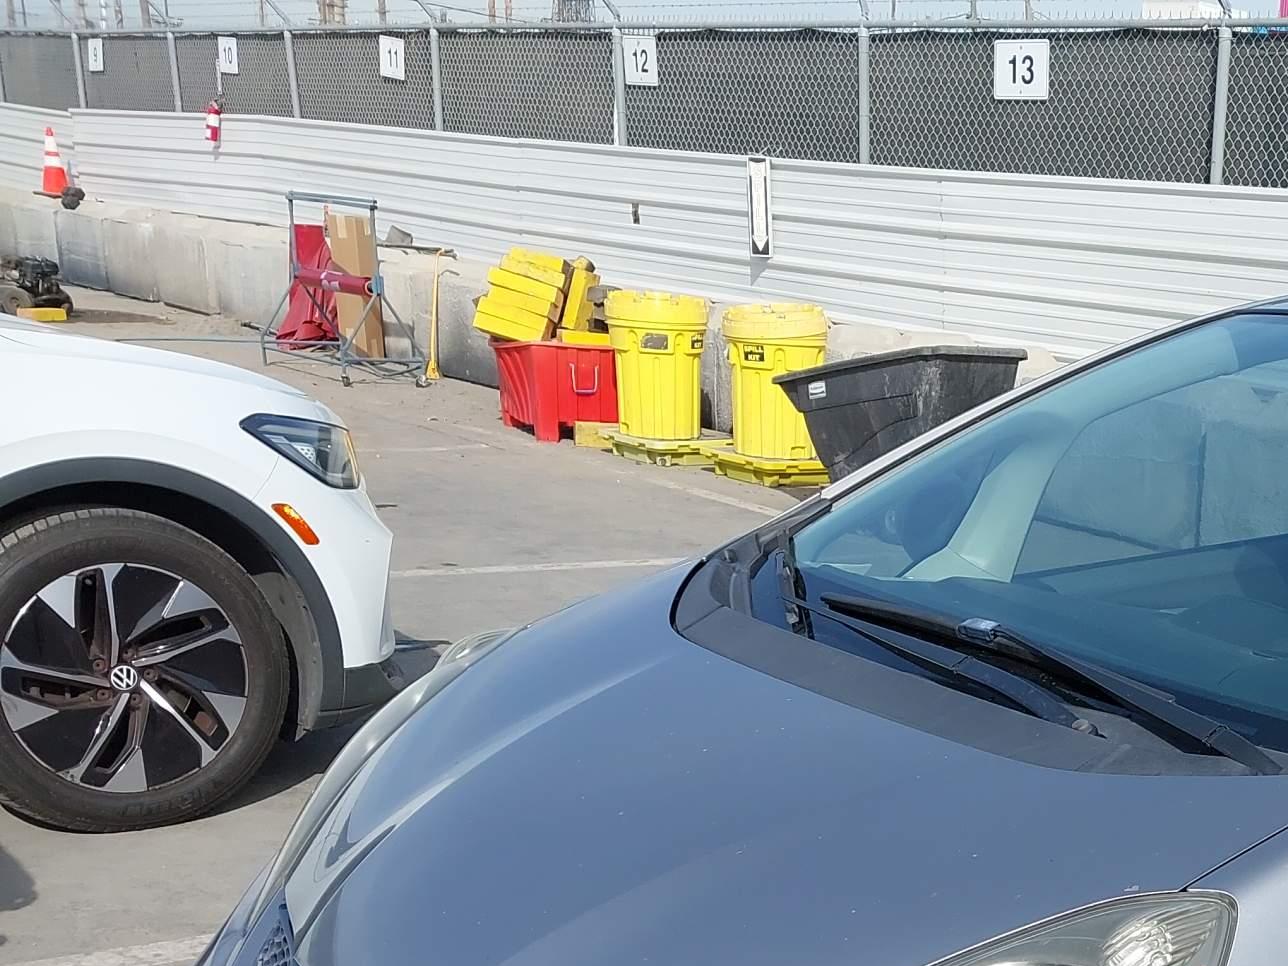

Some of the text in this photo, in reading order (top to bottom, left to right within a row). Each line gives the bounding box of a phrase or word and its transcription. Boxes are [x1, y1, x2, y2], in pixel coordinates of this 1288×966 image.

[93, 47, 98, 63] 9
[223, 47, 233, 64] 10
[387, 48, 399, 68] 11
[631, 49, 649, 73] 12
[1008, 54, 1034, 84] 13
[743, 345, 764, 353] SPILL
[747, 353, 761, 361] KIT
